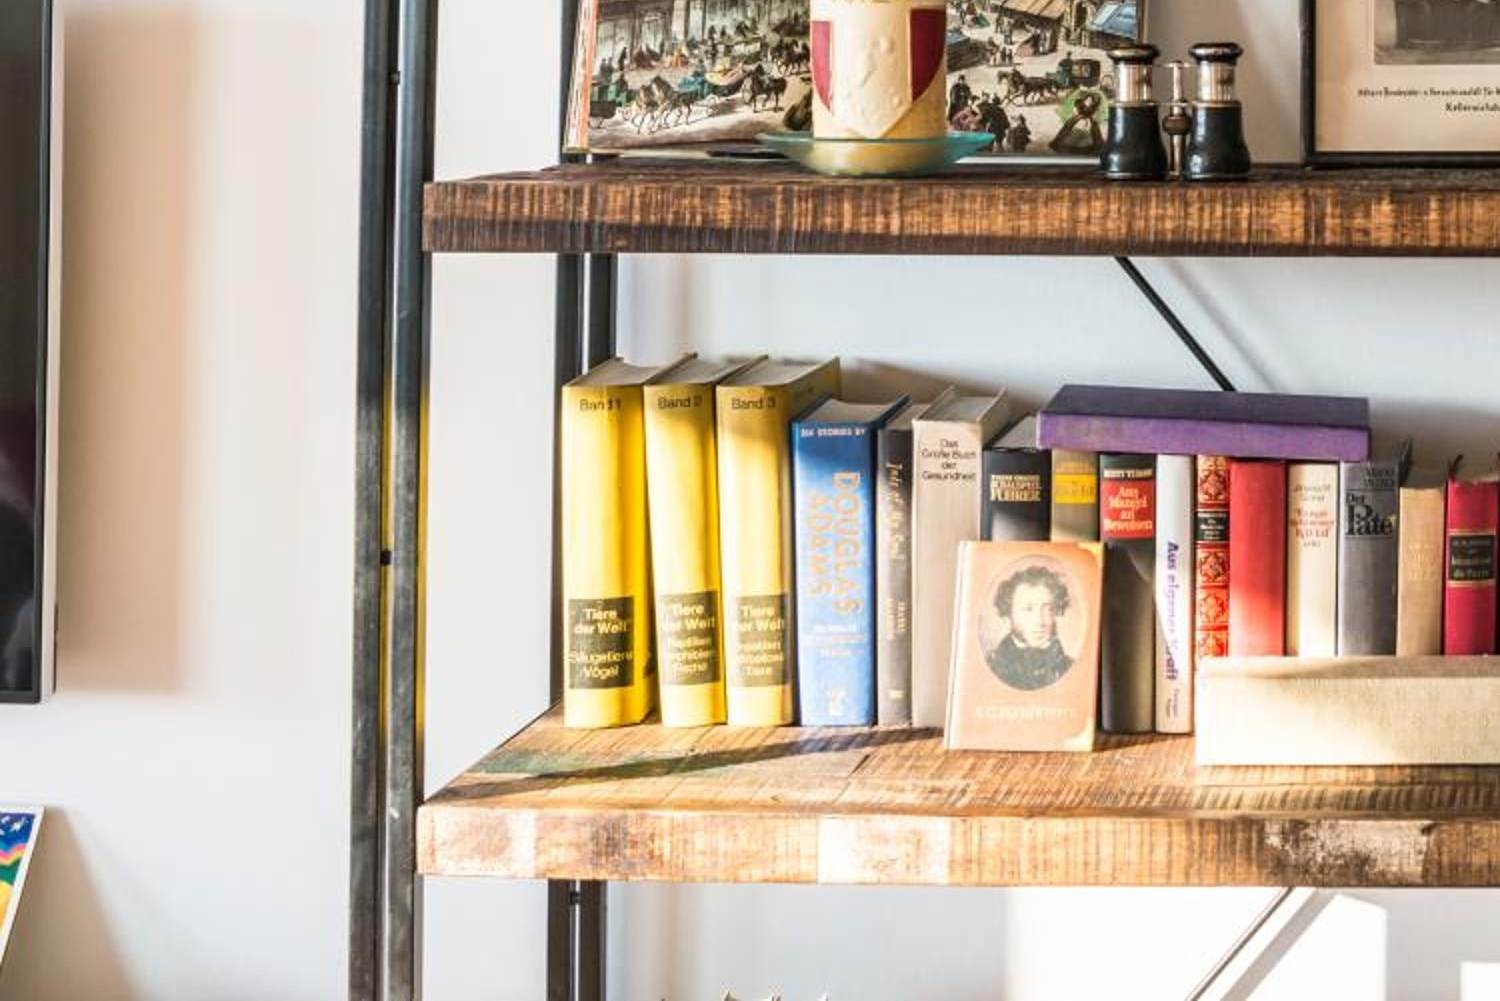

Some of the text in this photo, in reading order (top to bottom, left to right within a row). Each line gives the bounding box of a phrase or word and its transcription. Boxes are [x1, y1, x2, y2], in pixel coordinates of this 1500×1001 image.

[579, 398, 612, 412] Band
[657, 395, 690, 409] Band
[731, 396, 763, 410] Band
[940, 439, 959, 448] Das
[941, 461, 957, 470] der
[921, 470, 976, 481] Gesundheit
[1120, 486, 1138, 497] Aus
[1345, 492, 1366, 504] Der
[1344, 504, 1393, 536] Pate
[807, 492, 832, 598] ADAMS
[833, 471, 861, 615] DOUGLAS
[1166, 541, 1180, 570] Aus
[584, 607, 617, 621] Tiere
[671, 603, 705, 617] Tiere
[741, 605, 775, 618] Tiere
[574, 620, 627, 634] der Welt
[684, 617, 716, 632] Welt
[756, 617, 786, 633] Welt
[581, 664, 620, 681] Vögel
